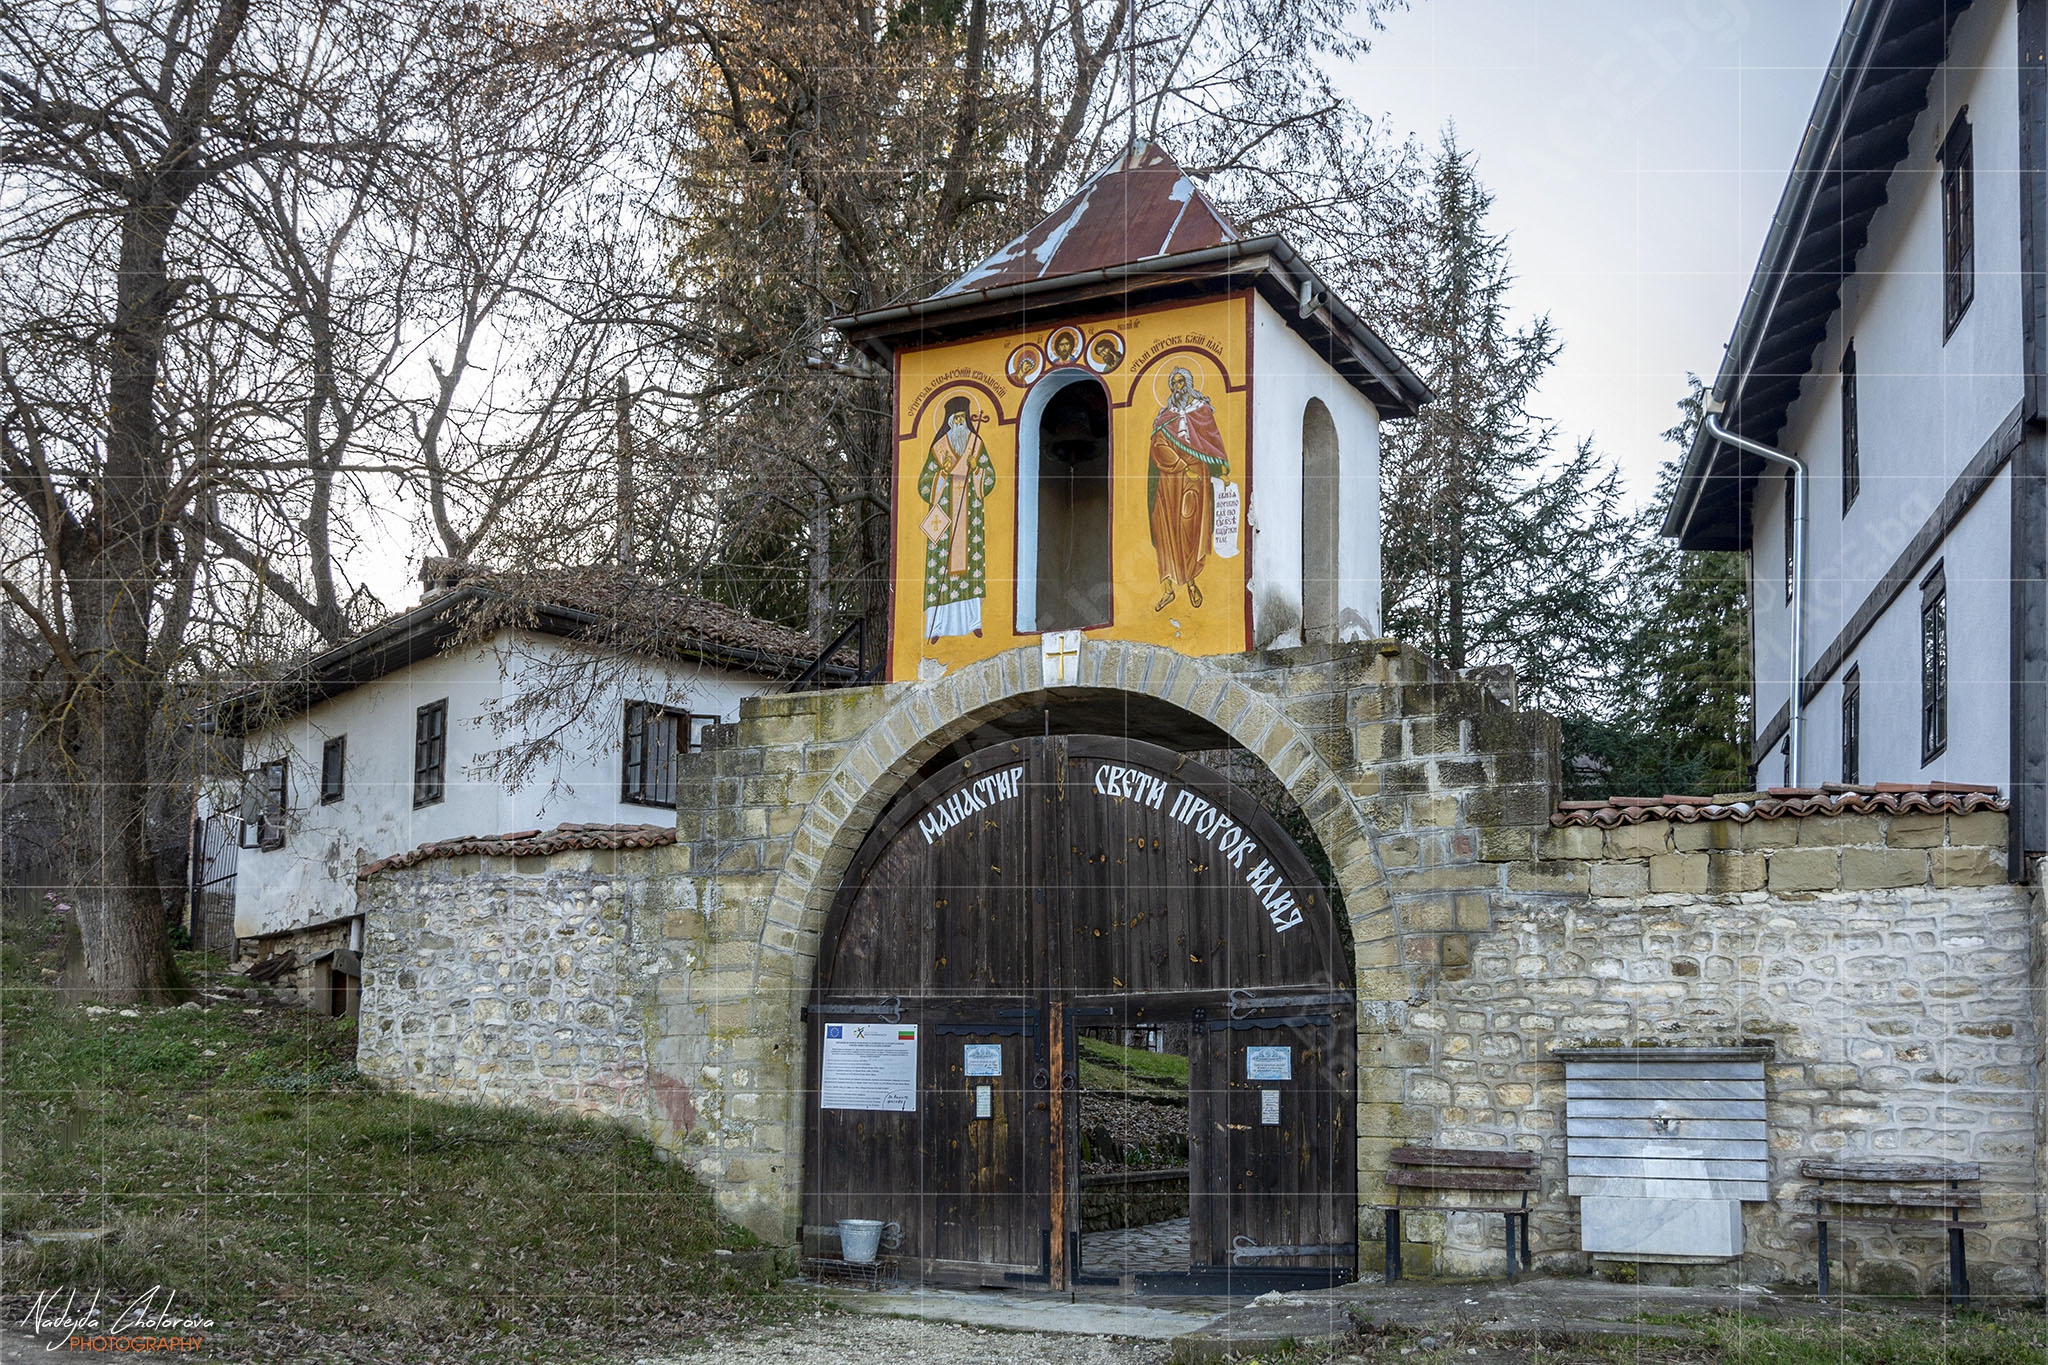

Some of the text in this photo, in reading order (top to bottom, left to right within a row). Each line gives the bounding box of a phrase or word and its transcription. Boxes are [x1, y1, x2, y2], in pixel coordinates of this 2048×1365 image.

[918, 763, 1305, 934] МАНАСТИР СВЕТИ ПРОРОК ИЛИЯ
